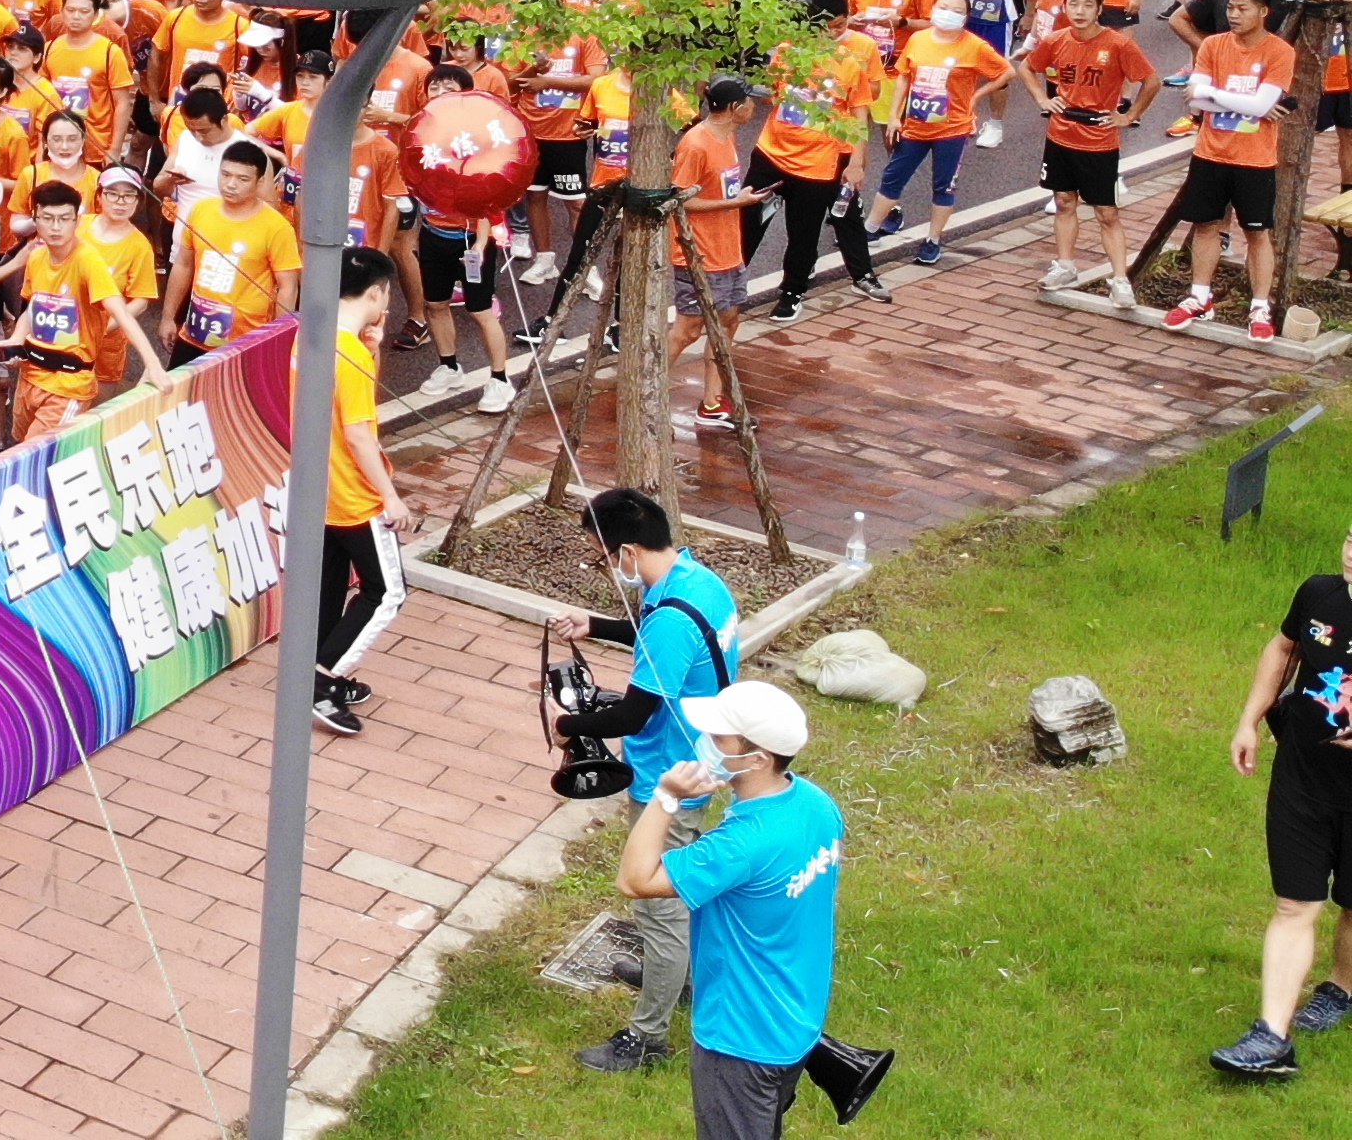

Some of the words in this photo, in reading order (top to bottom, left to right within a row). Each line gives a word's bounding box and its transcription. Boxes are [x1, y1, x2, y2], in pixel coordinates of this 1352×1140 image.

[1059, 63, 1104, 87] 卓尔
[912, 99, 941, 113] 077
[419, 119, 513, 170] 教练员
[35, 310, 69, 329] 045
[191, 311, 222, 335] 113
